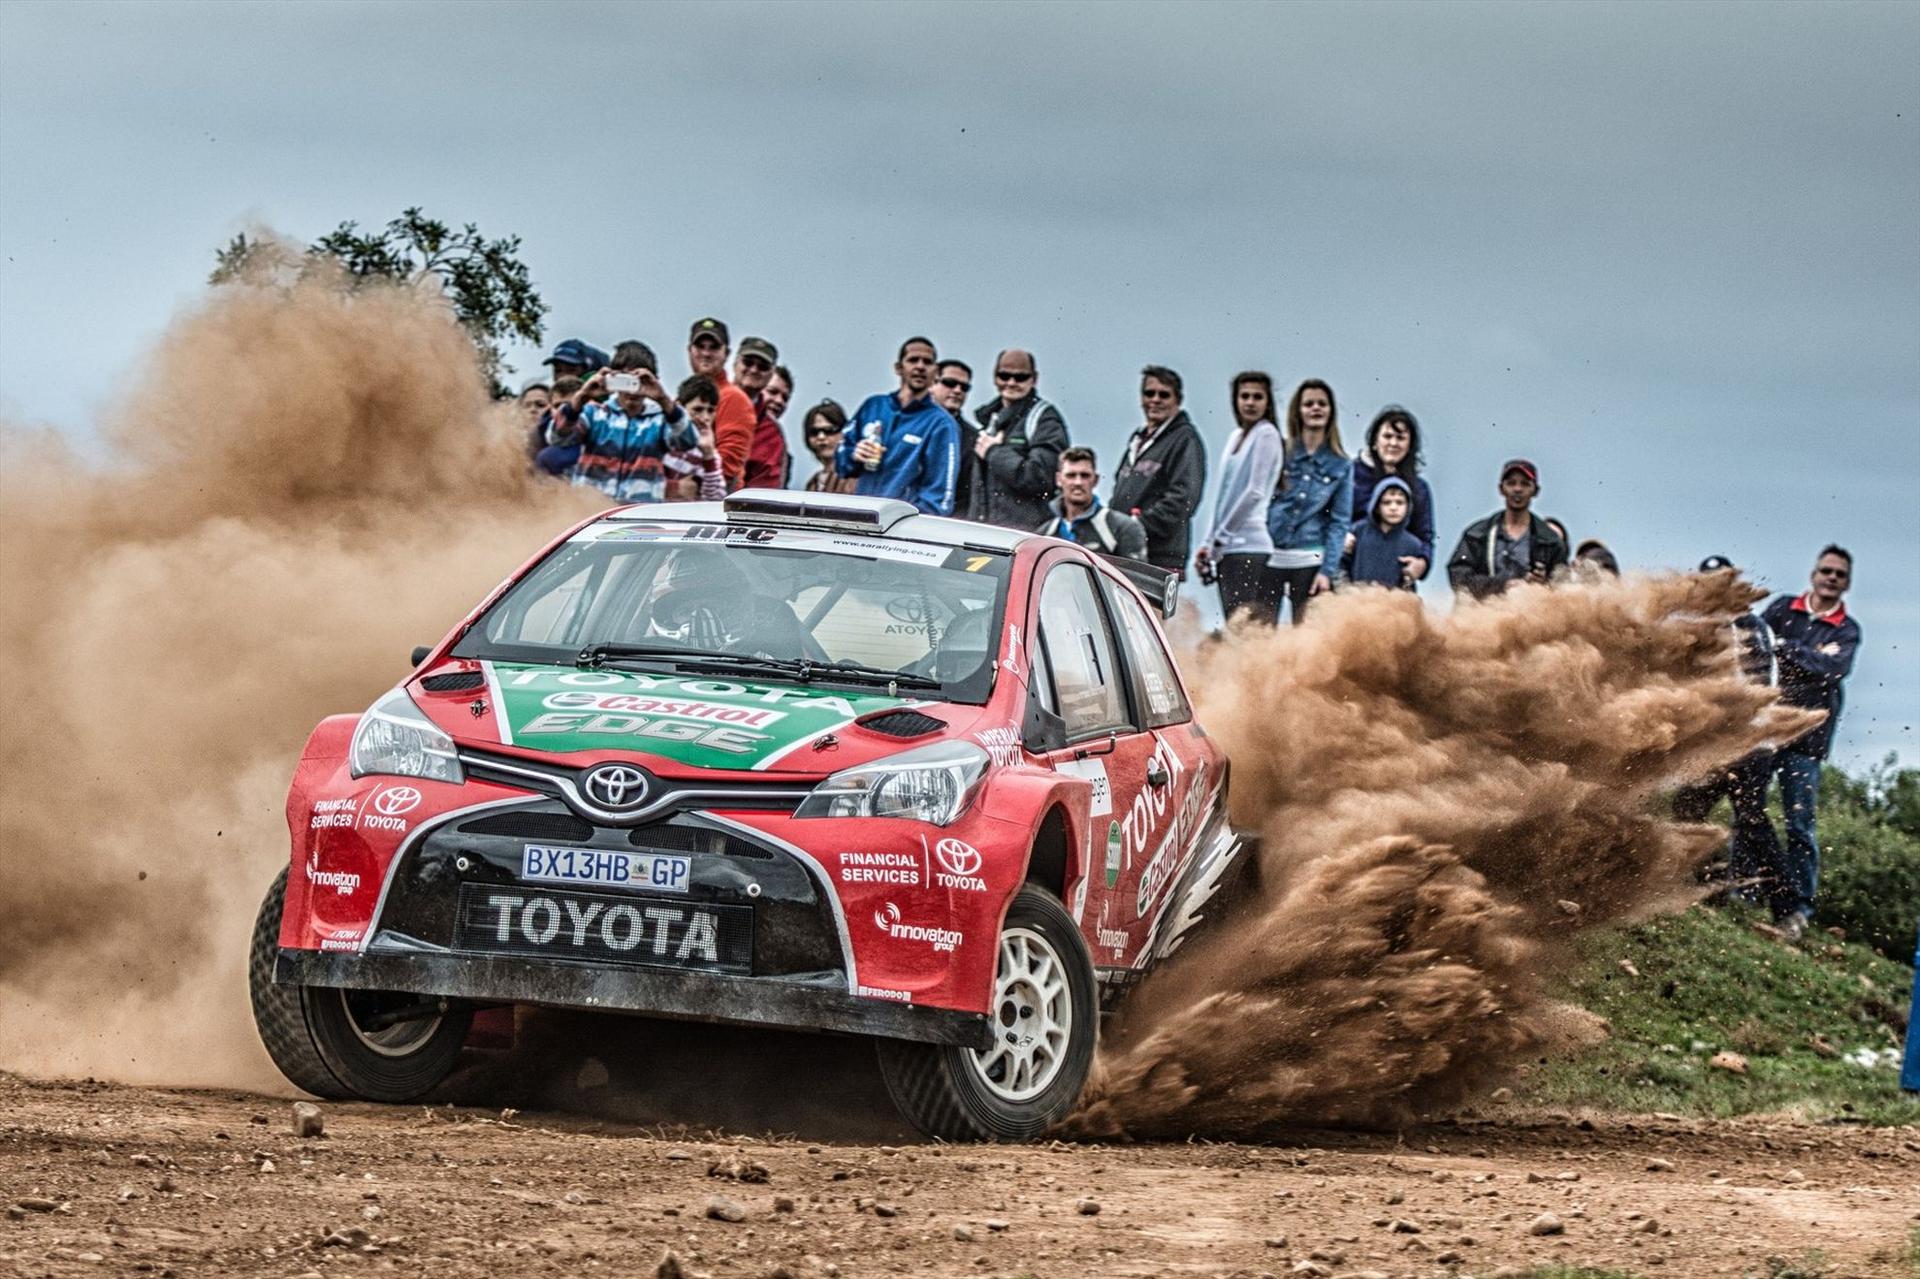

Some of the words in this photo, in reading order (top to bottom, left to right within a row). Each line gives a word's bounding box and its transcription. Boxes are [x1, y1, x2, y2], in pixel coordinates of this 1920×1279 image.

[832, 538, 937, 558] www.sarallying.co.za
[965, 556, 993, 572] 1
[506, 669, 857, 719] TOYOTA
[596, 695, 772, 727] Castrol
[519, 712, 776, 754] EDGE
[974, 727, 1022, 746] IMPERIAL
[986, 744, 1026, 768] TOYOTA
[314, 799, 357, 812] FINANCIAL
[311, 814, 353, 829] SERVICES
[364, 815, 407, 831] TOYOTA
[526, 848, 630, 882] BX13HB
[652, 858, 687, 886] GP
[839, 852, 919, 868] FINANCIAL
[311, 871, 360, 887] nnovation
[841, 868, 919, 884] SERVICES
[936, 873, 987, 891] TOYOTA
[488, 895, 718, 961] TOYOTA
[891, 924, 963, 945] innovation
[934, 942, 955, 953] group
[867, 987, 903, 999] FERODO
